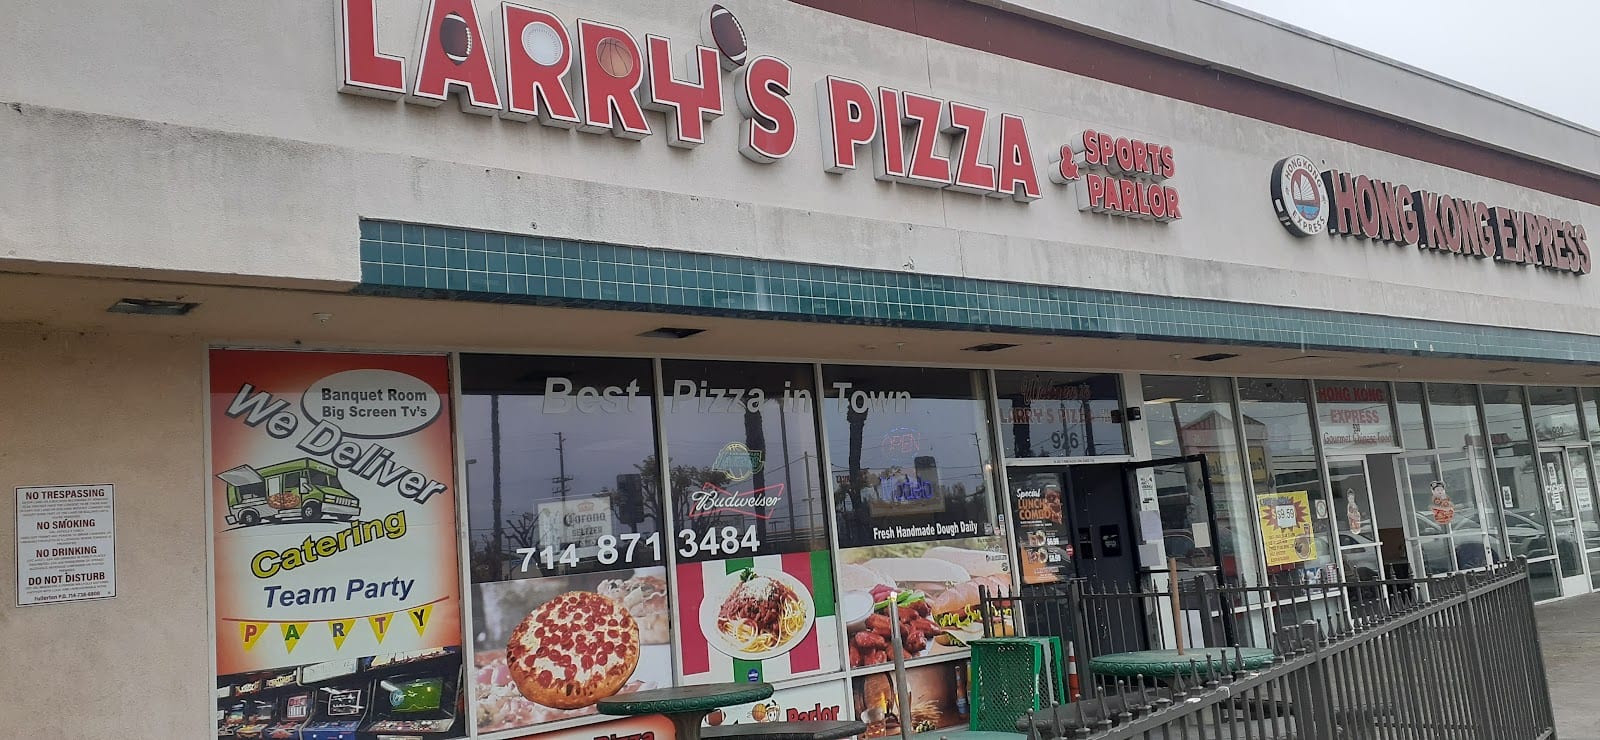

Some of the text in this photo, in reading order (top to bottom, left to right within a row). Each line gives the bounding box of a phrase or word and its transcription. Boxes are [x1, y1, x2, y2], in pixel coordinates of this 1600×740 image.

[337, 0, 1043, 202] LARRY'S PIZZA
[1056, 144, 1079, 183] &
[1080, 128, 1175, 180] SPORTS
[1285, 158, 1323, 187] HONG KONG
[1083, 173, 1182, 221] PARLOR
[1292, 210, 1325, 233] EXPRESS
[1327, 169, 1592, 275] HONG KONG EXPRESS
[321, 388, 427, 403] Banquet Room
[542, 376, 911, 414] Best Pizza in Town
[1318, 386, 1383, 401] HONG KONG
[322, 405, 427, 419] Big Screen Tv's
[1330, 409, 1380, 423] EXPRESS
[225, 383, 447, 504] We Deliver
[1051, 432, 1079, 449] 926
[25, 489, 105, 500] NO TRESPASSING
[691, 490, 782, 511] Budweiser
[1016, 488, 1041, 500] Special
[1018, 498, 1044, 509] LUNCH
[36, 519, 96, 530] NO SMOKING
[563, 512, 607, 527] Corona
[1019, 509, 1051, 521] COMBO
[873, 520, 978, 540] Fresh Handmade Dough Daily
[36, 546, 97, 558] NO DRINKING
[251, 510, 407, 579] Catering
[516, 524, 761, 573] 714 871 3484
[28, 572, 105, 586] DO NOT DISTURB
[263, 577, 415, 608] Team Party
